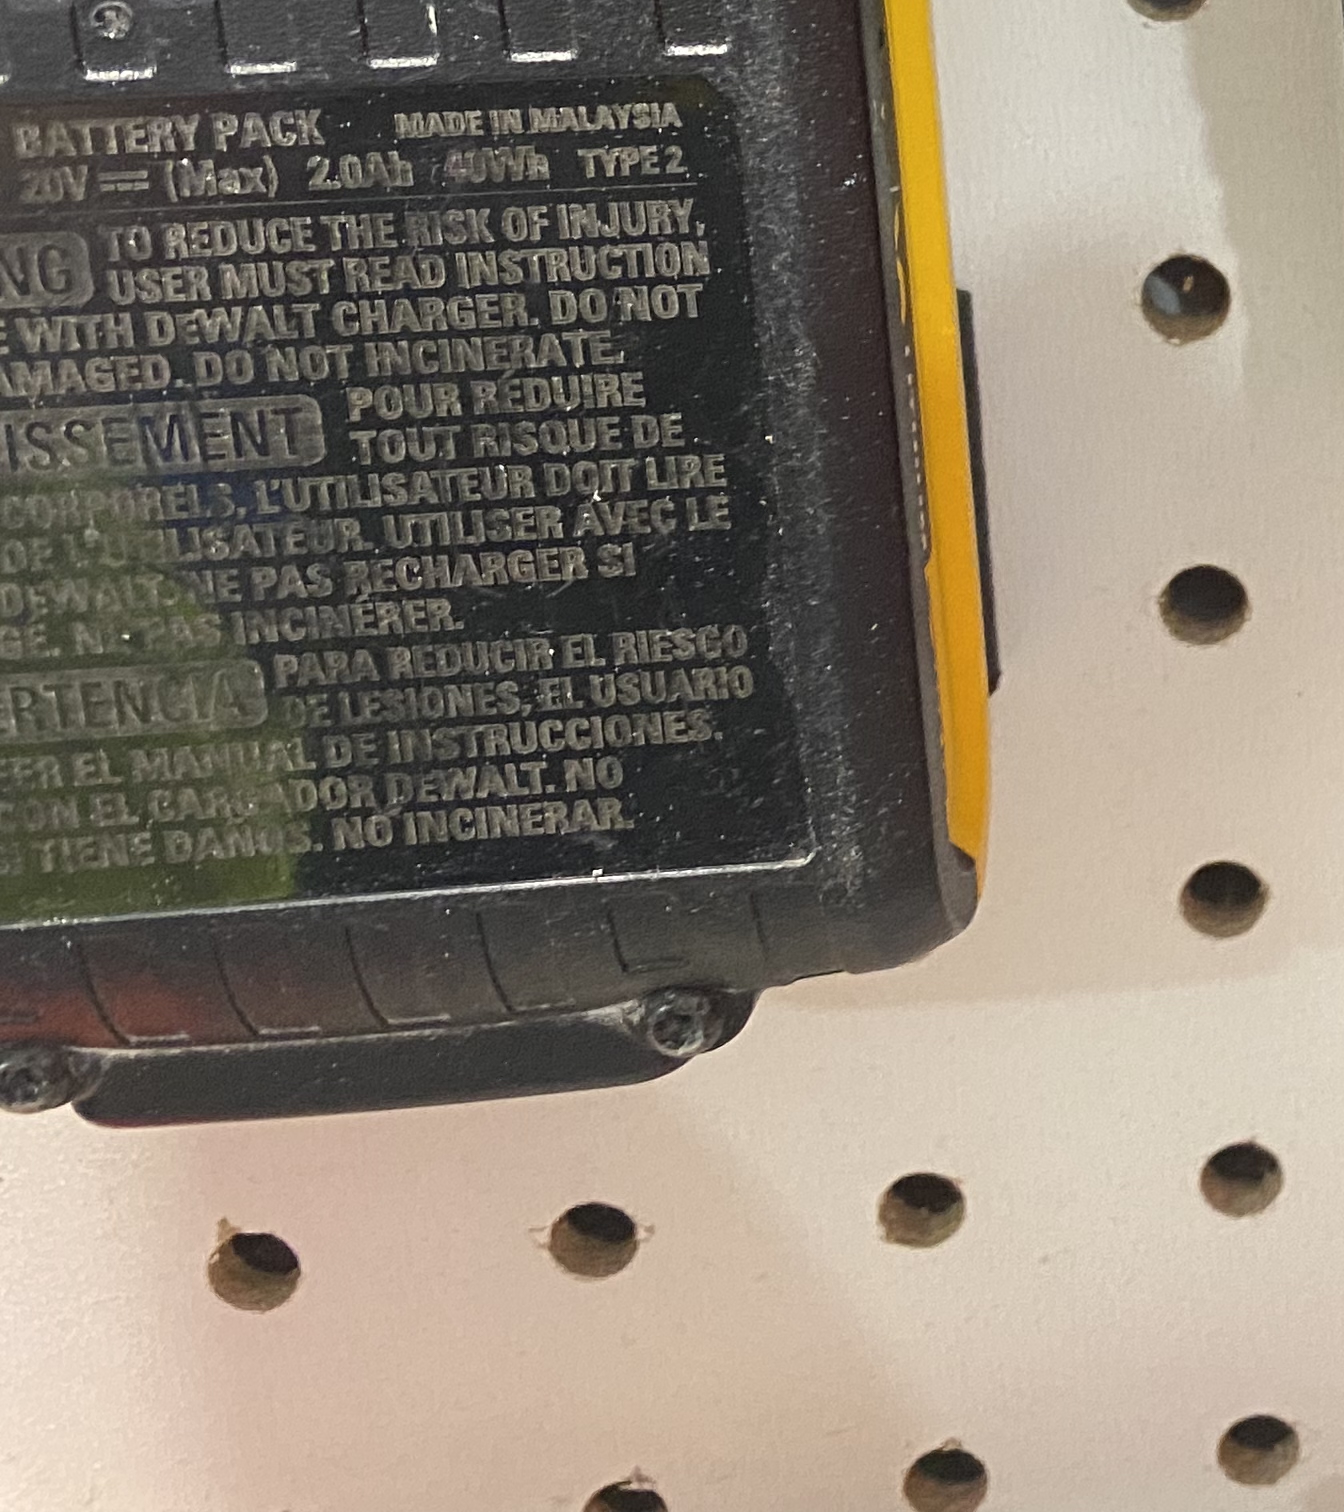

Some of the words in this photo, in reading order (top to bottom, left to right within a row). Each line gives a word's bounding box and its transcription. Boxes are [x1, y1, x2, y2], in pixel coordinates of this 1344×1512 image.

[12, 112, 200, 160] BATTERY
[211, 108, 326, 152] PACK
[393, 109, 483, 139] MADE
[489, 107, 525, 135] IN
[528, 102, 683, 134] MALAYSIA
[163, 155, 279, 203] (Max)
[307, 150, 415, 191] 2.0Ah
[577, 145, 660, 180] TYPE
[664, 144, 688, 174] 2
[98, 224, 153, 263] TO
[161, 217, 316, 259] REDUCE
[320, 212, 398, 252] THE
[404, 207, 496, 247] RISK
[501, 204, 549, 243] OF
[557, 198, 705, 241] INJURY,
[105, 265, 212, 305] USER
[218, 258, 336, 300] MUST
[342, 254, 446, 293] READ
[455, 240, 711, 289] INSTRUCTION
[15, 312, 135, 353] WITH
[145, 303, 321, 348] DEWALT
[331, 292, 540, 337] CHARGER.
[549, 288, 608, 325] DO
[616, 283, 704, 322] NOT
[0, 353, 191, 396] MAGED.
[194, 350, 254, 386] DO
[266, 344, 354, 383] NOT
[364, 329, 626, 377] INCINERATE.
[2, 406, 304, 472] ISSEMENT
[345, 381, 462, 422] POUR
[470, 370, 647, 414] RÉDUIRE
[349, 424, 462, 465] TOUT
[470, 416, 624, 458] RISQUE
[631, 412, 686, 449] DE
[254, 464, 536, 516] L'UTILISATEUR
[543, 456, 637, 497] DOIT
[645, 453, 729, 491] LIRE
[383, 504, 564, 549] UTILISER
[574, 497, 677, 538] AVEC
[686, 495, 732, 531] LE
[251, 563, 334, 602] PAS
[343, 545, 589, 593] RECHARGER
[597, 541, 637, 579] SI
[0, 670, 250, 734] RTENCIA
[273, 648, 381, 689] PARA
[387, 638, 554, 681] REDUCIR
[561, 633, 606, 669] EL
[612, 624, 749, 666] RIESGO
[281, 693, 333, 730] DE
[341, 680, 531, 727] LESIONES,
[538, 675, 584, 711] EL
[589, 665, 755, 708] USUARIO
[72, 748, 124, 787] EL
[323, 732, 381, 769] DE
[388, 707, 724, 764] INSTRUCCIONES.
[90, 792, 140, 827] EL
[385, 760, 556, 804] DEWALT.
[563, 754, 624, 793] NO
[332, 814, 393, 852] NO
[402, 795, 636, 847] INCINERAR.
